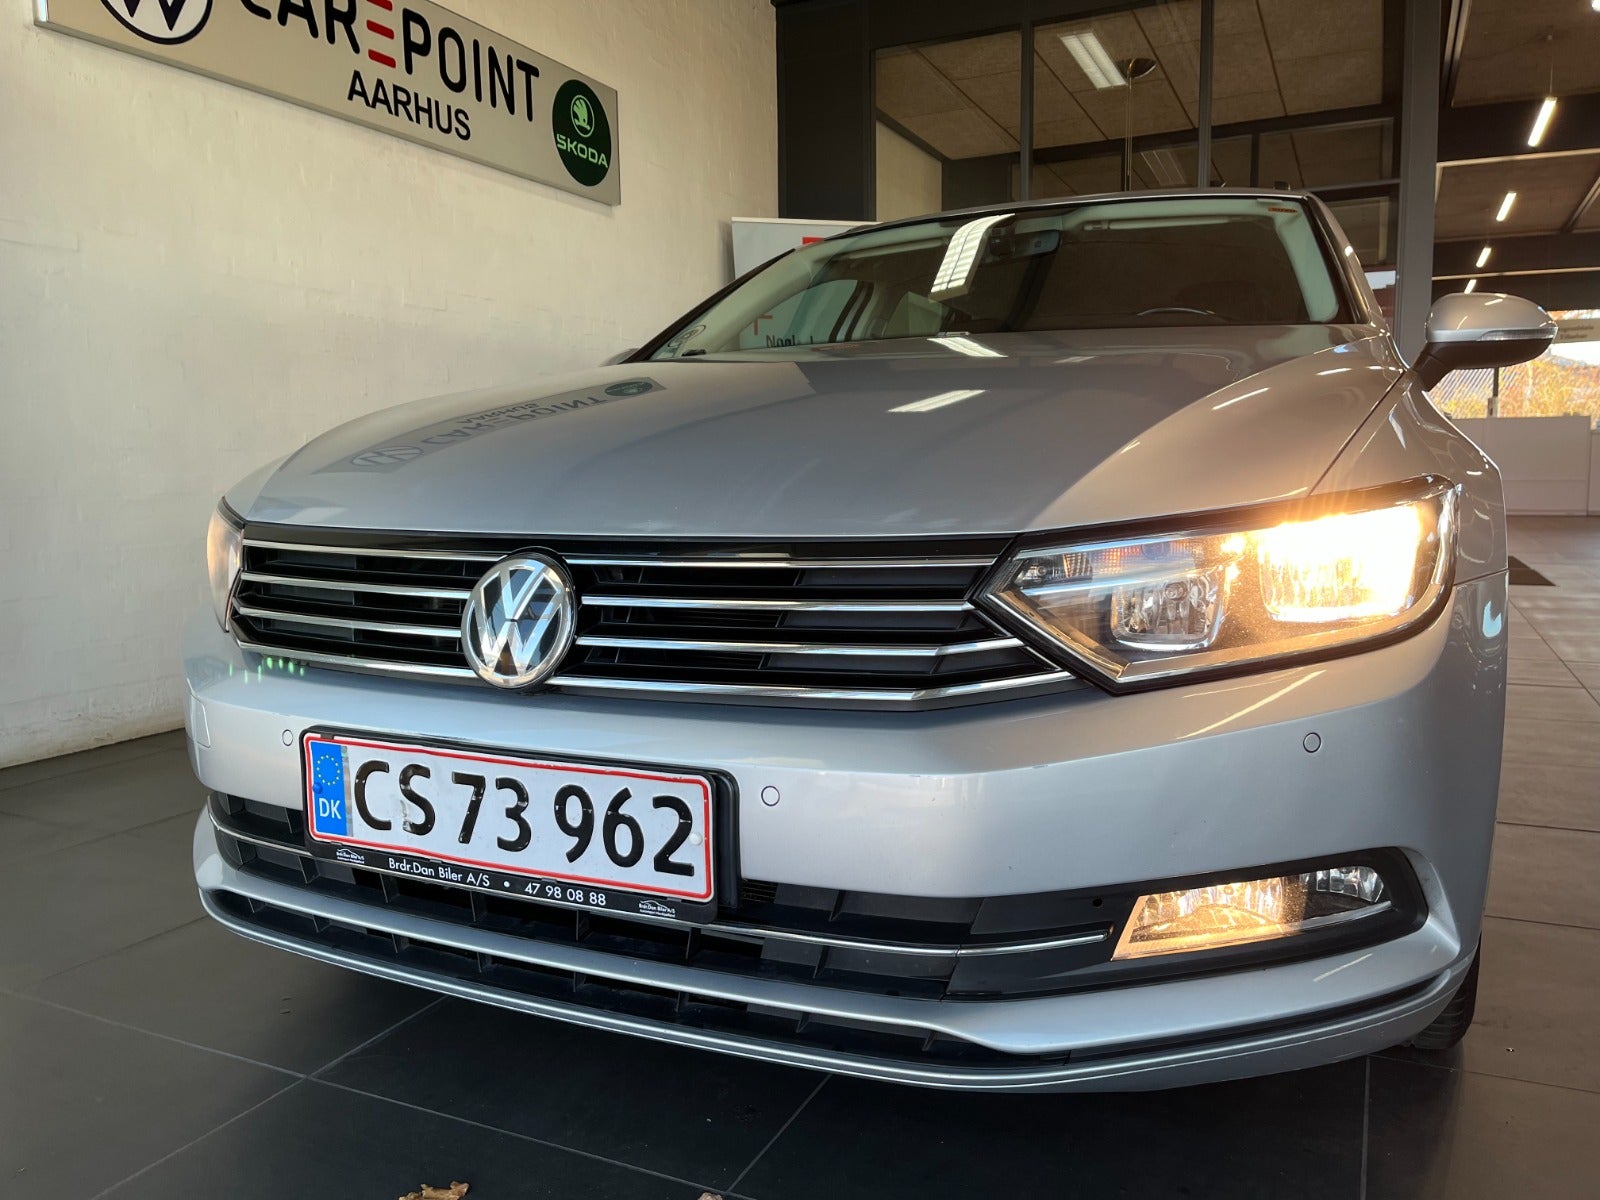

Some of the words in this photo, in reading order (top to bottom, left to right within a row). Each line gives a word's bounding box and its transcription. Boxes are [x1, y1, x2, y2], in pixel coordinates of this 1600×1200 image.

[240, 0, 540, 122] AREPOINT
[347, 69, 471, 141] AARHUS
[319, 797, 342, 820] DK
[354, 760, 436, 836] CS
[451, 771, 532, 852] 73
[554, 784, 695, 877] 962
[388, 857, 435, 877] Brdr.Dan
[438, 864, 463, 881] Biler
[466, 872, 490, 887] A/S
[524, 882, 541, 895] 47
[545, 885, 562, 899] 98
[566, 888, 584, 902] 08
[589, 892, 607, 906] 88
